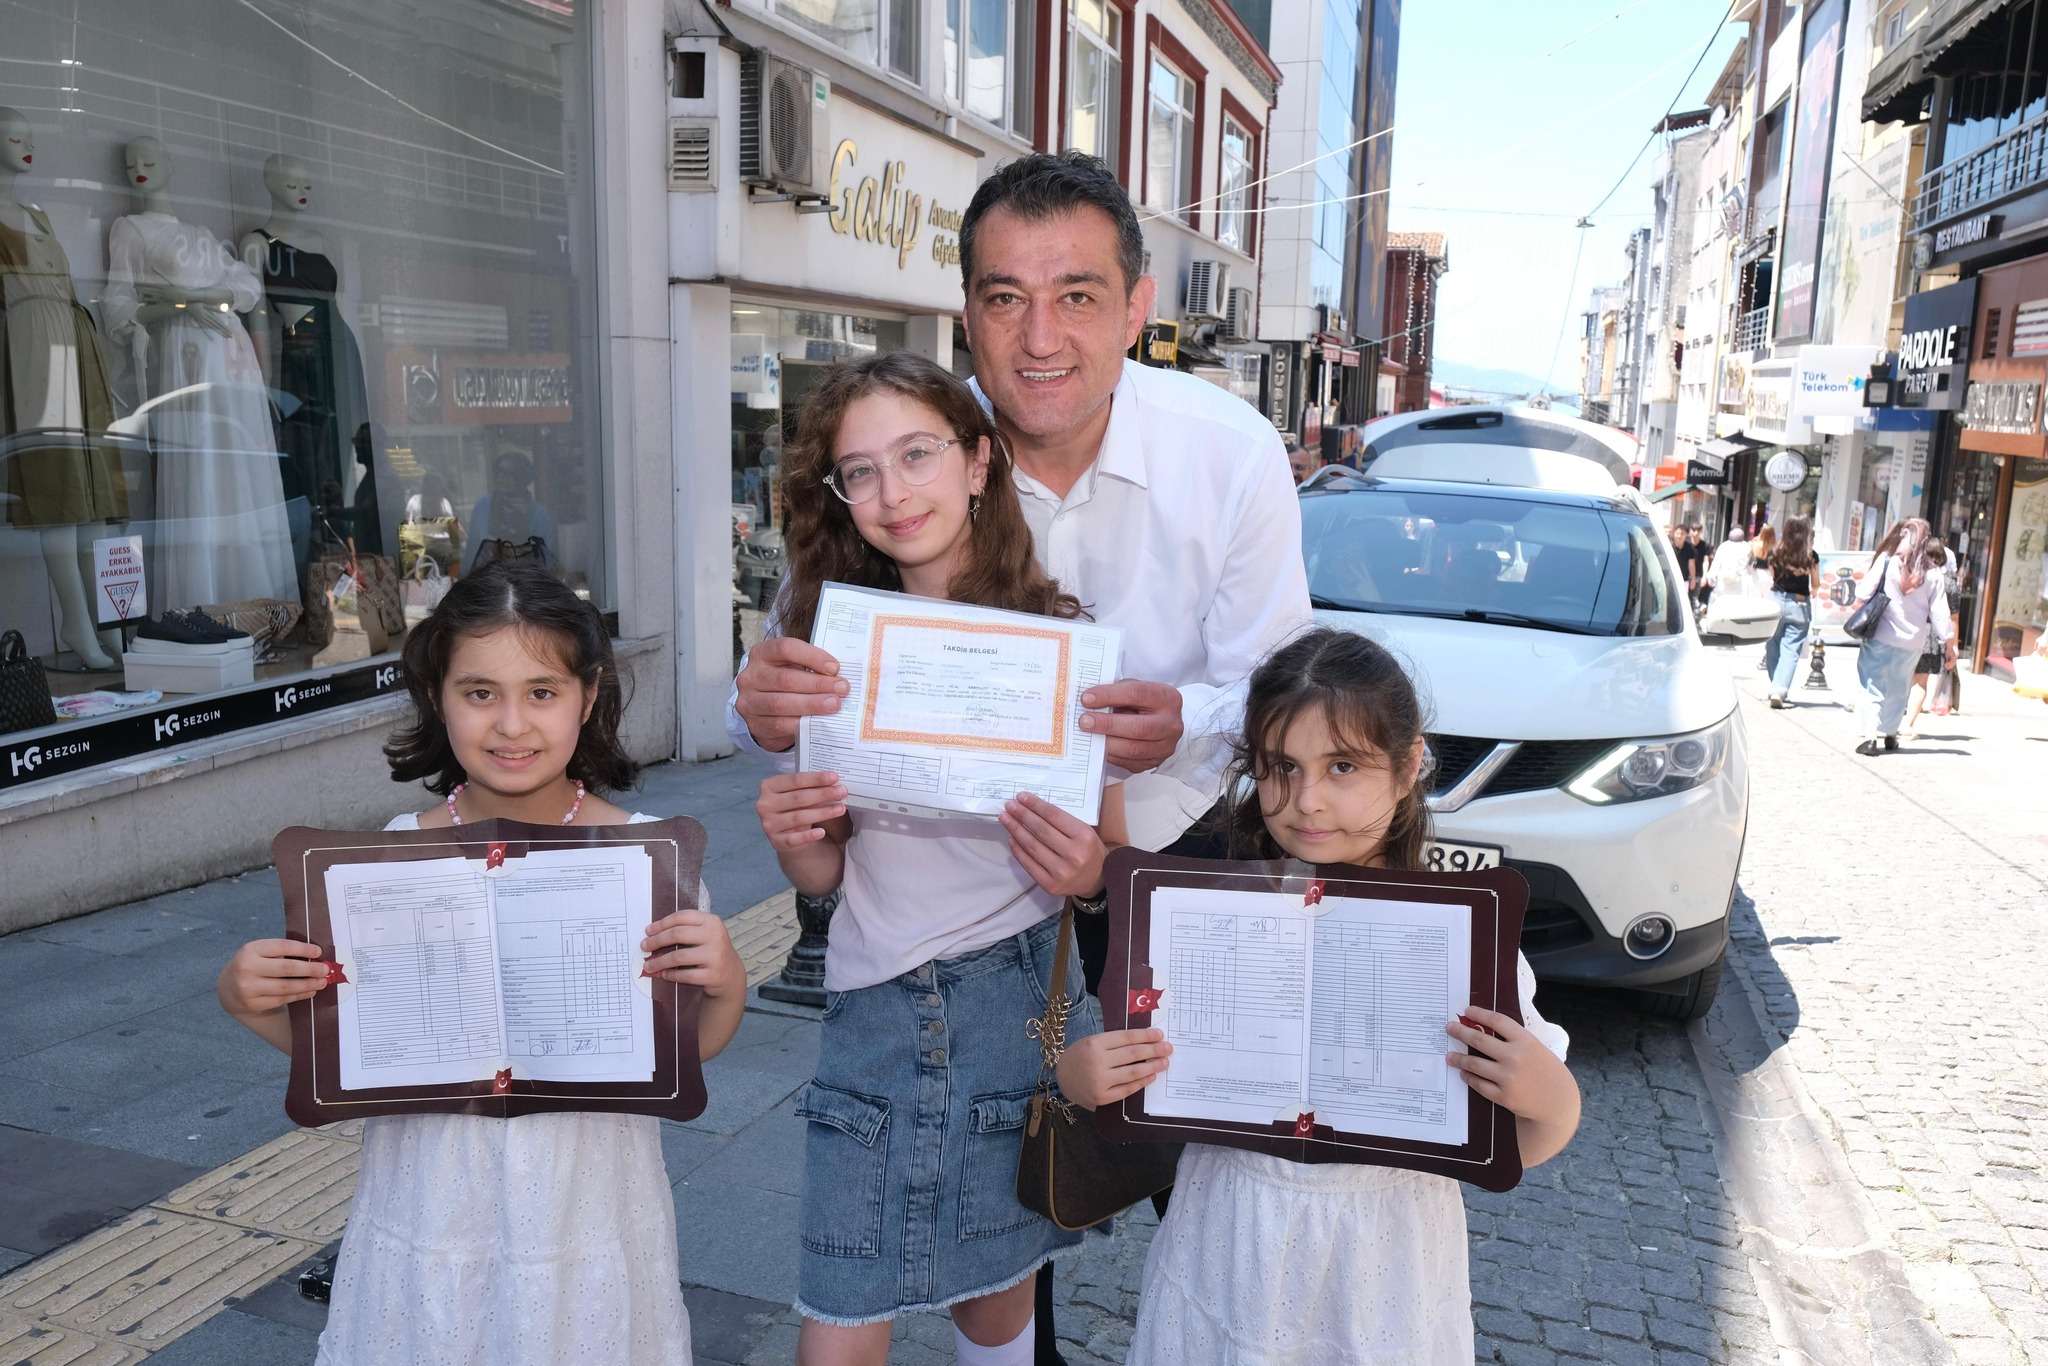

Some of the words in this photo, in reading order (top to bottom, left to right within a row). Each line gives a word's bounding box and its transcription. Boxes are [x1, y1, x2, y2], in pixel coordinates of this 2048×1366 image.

[829, 138, 922, 270] Galip
[1935, 214, 1991, 253] RESTAURANT
[1898, 325, 1957, 369] PARDOLE
[1803, 371, 1827, 381] Türk
[1905, 372, 1939, 394] PARFUM
[1271, 348, 1286, 427] DOUBLE
[1802, 382, 1848, 392] Telekom
[1690, 467, 1726, 477] flormar
[109, 546, 131, 556] GUESS
[108, 557, 133, 567] ERKEK
[100, 566, 142, 578] AYAKKABISI
[109, 585, 134, 596] GUESS
[943, 644, 968, 653] TAKDİR
[969, 647, 998, 655] BELGESİ
[299, 684, 331, 700] SEZGIN
[183, 709, 221, 728] SEZGIN
[45, 741, 91, 760] SEZGIN
